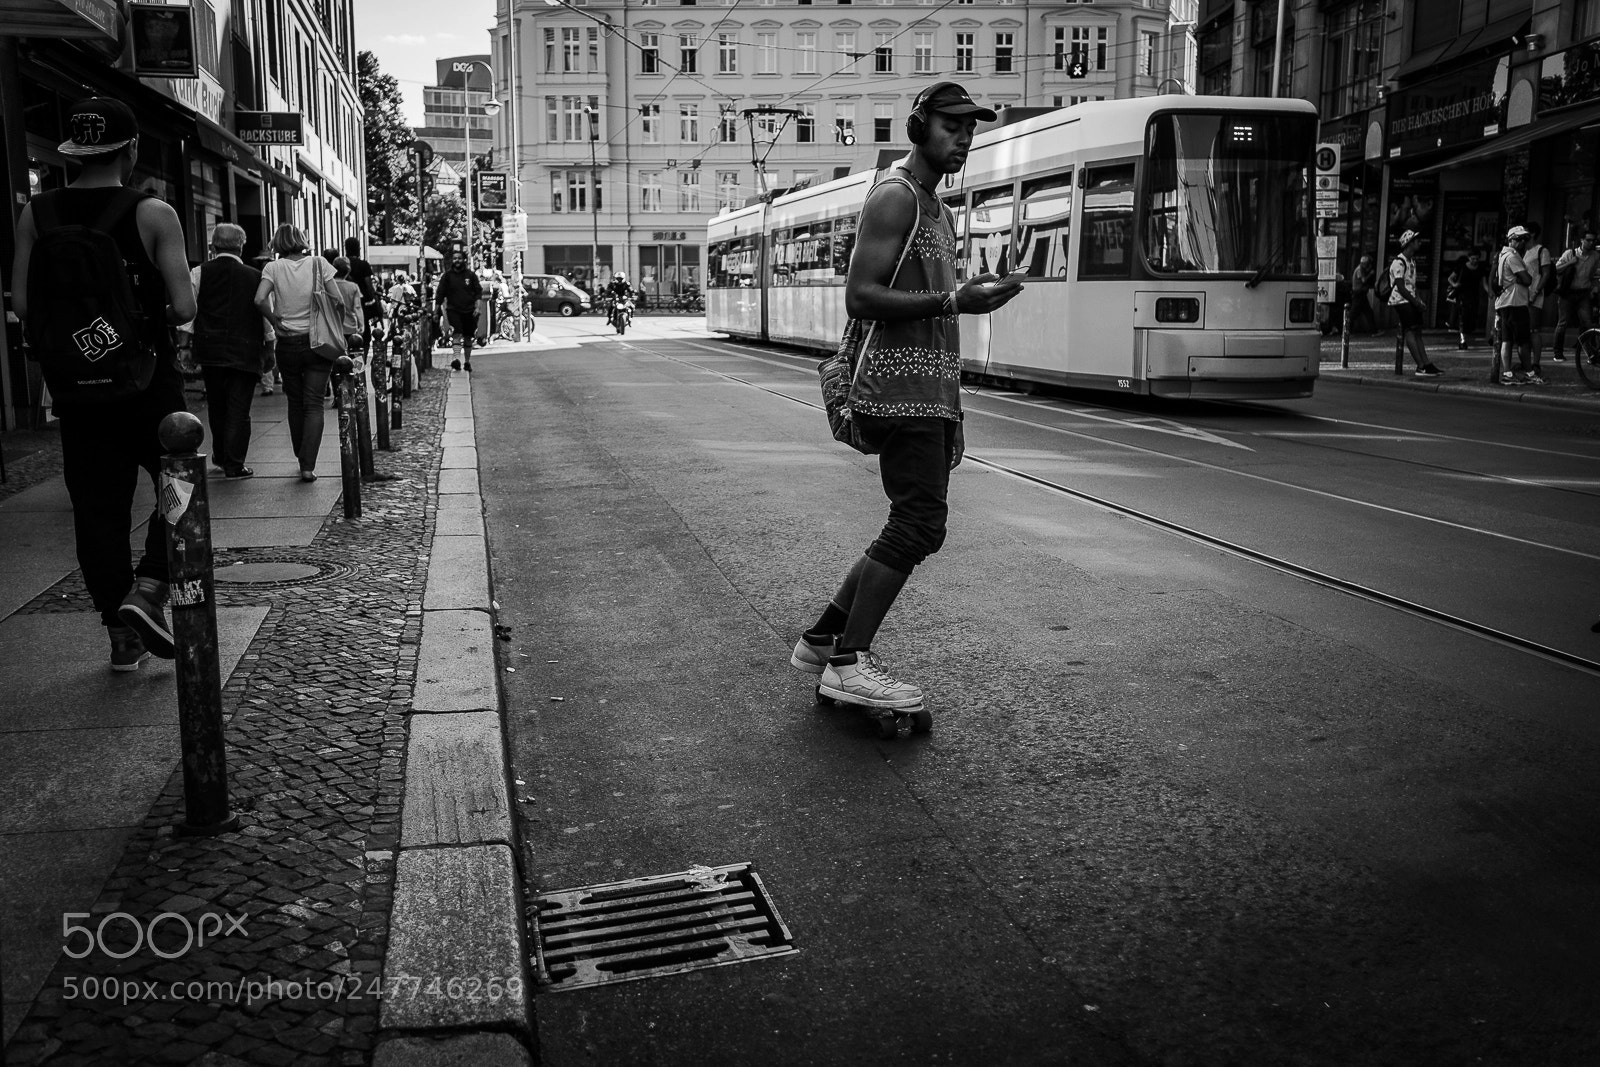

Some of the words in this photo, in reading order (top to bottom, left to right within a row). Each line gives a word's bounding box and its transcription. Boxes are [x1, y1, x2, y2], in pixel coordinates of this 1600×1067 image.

[1391, 118, 1407, 135] DIE
[1408, 99, 1471, 131] HACKESCHEN
[239, 129, 297, 142] BACKSTUBE
[1320, 153, 1331, 166] H
[1117, 379, 1130, 388] 1552
